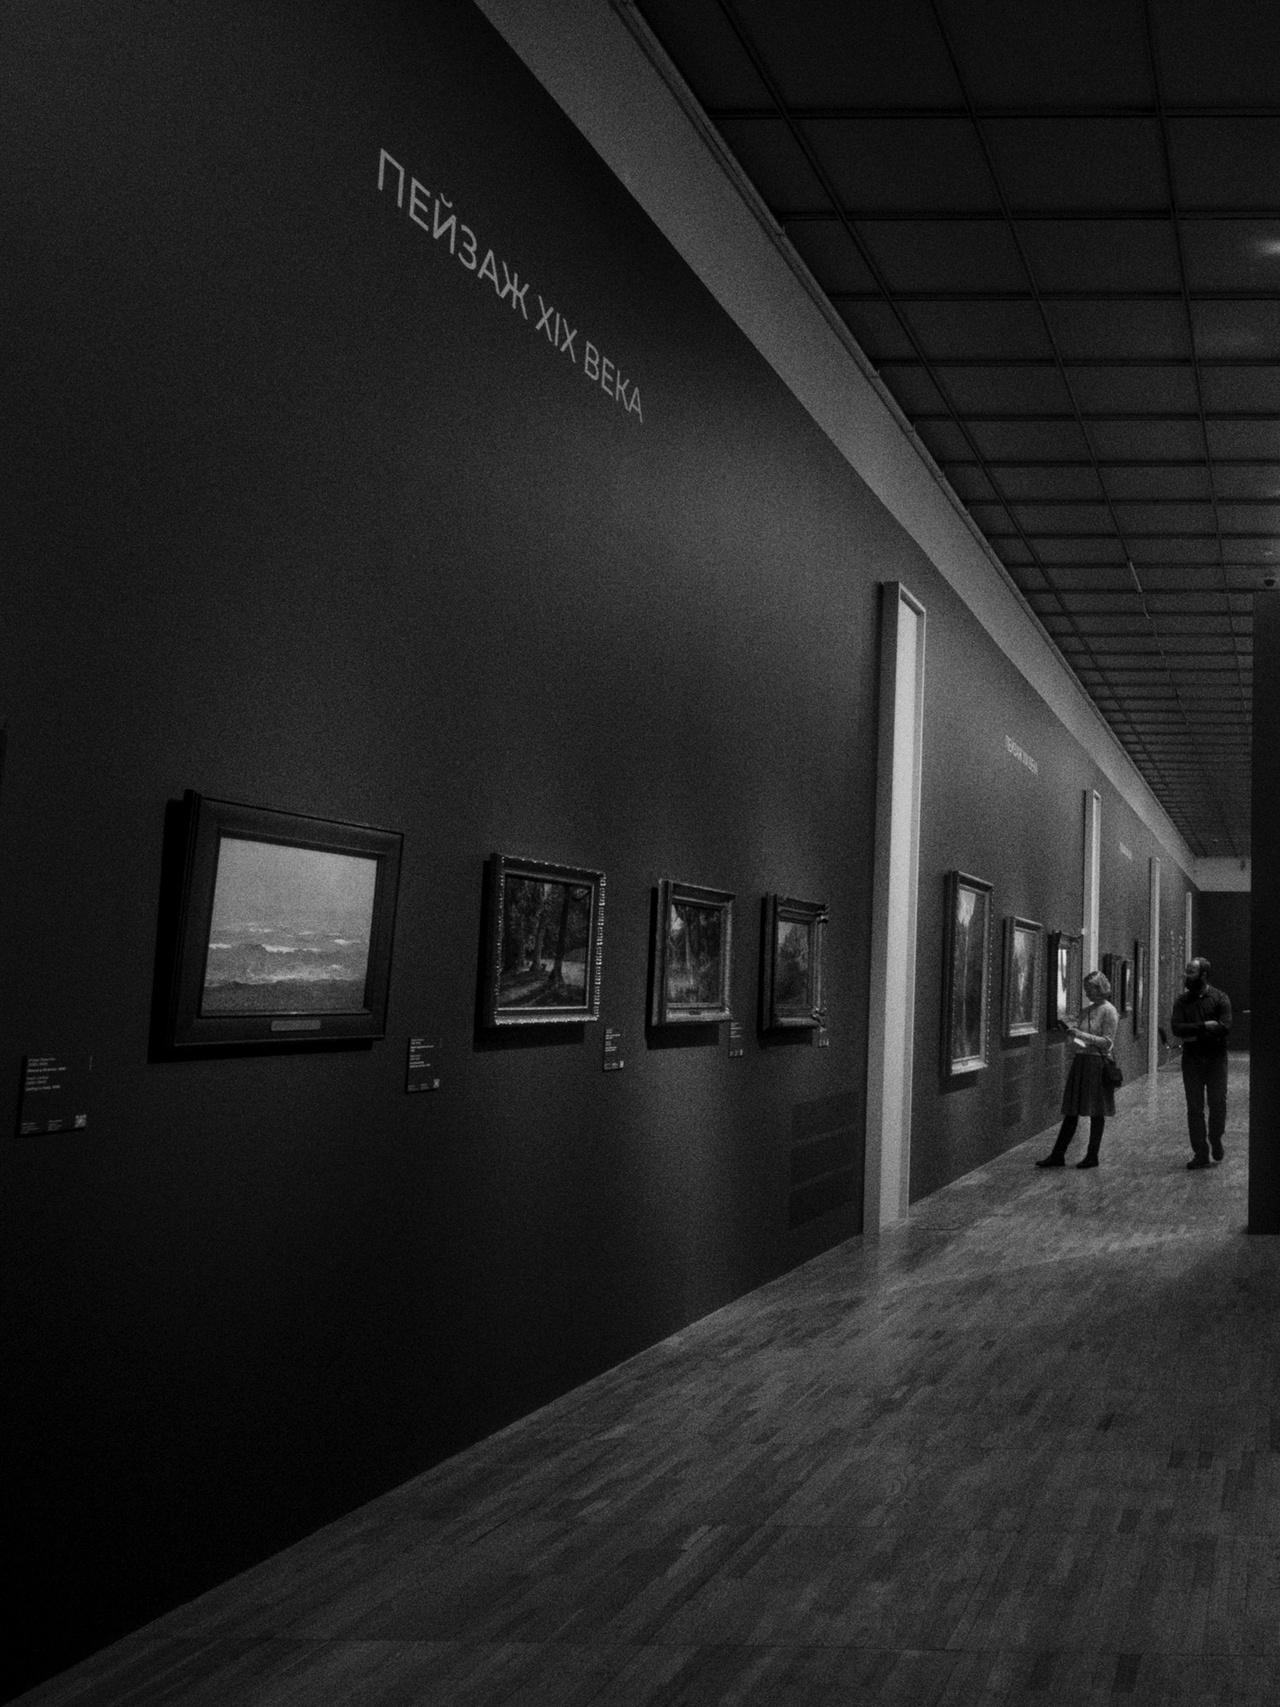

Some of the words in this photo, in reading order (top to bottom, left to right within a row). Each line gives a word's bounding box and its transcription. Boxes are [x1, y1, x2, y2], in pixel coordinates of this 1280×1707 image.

[377, 148, 530, 321] ПЕЙЗАЖ
[535, 294, 578, 363] XIX
[584, 340, 643, 423] ВЕКА
